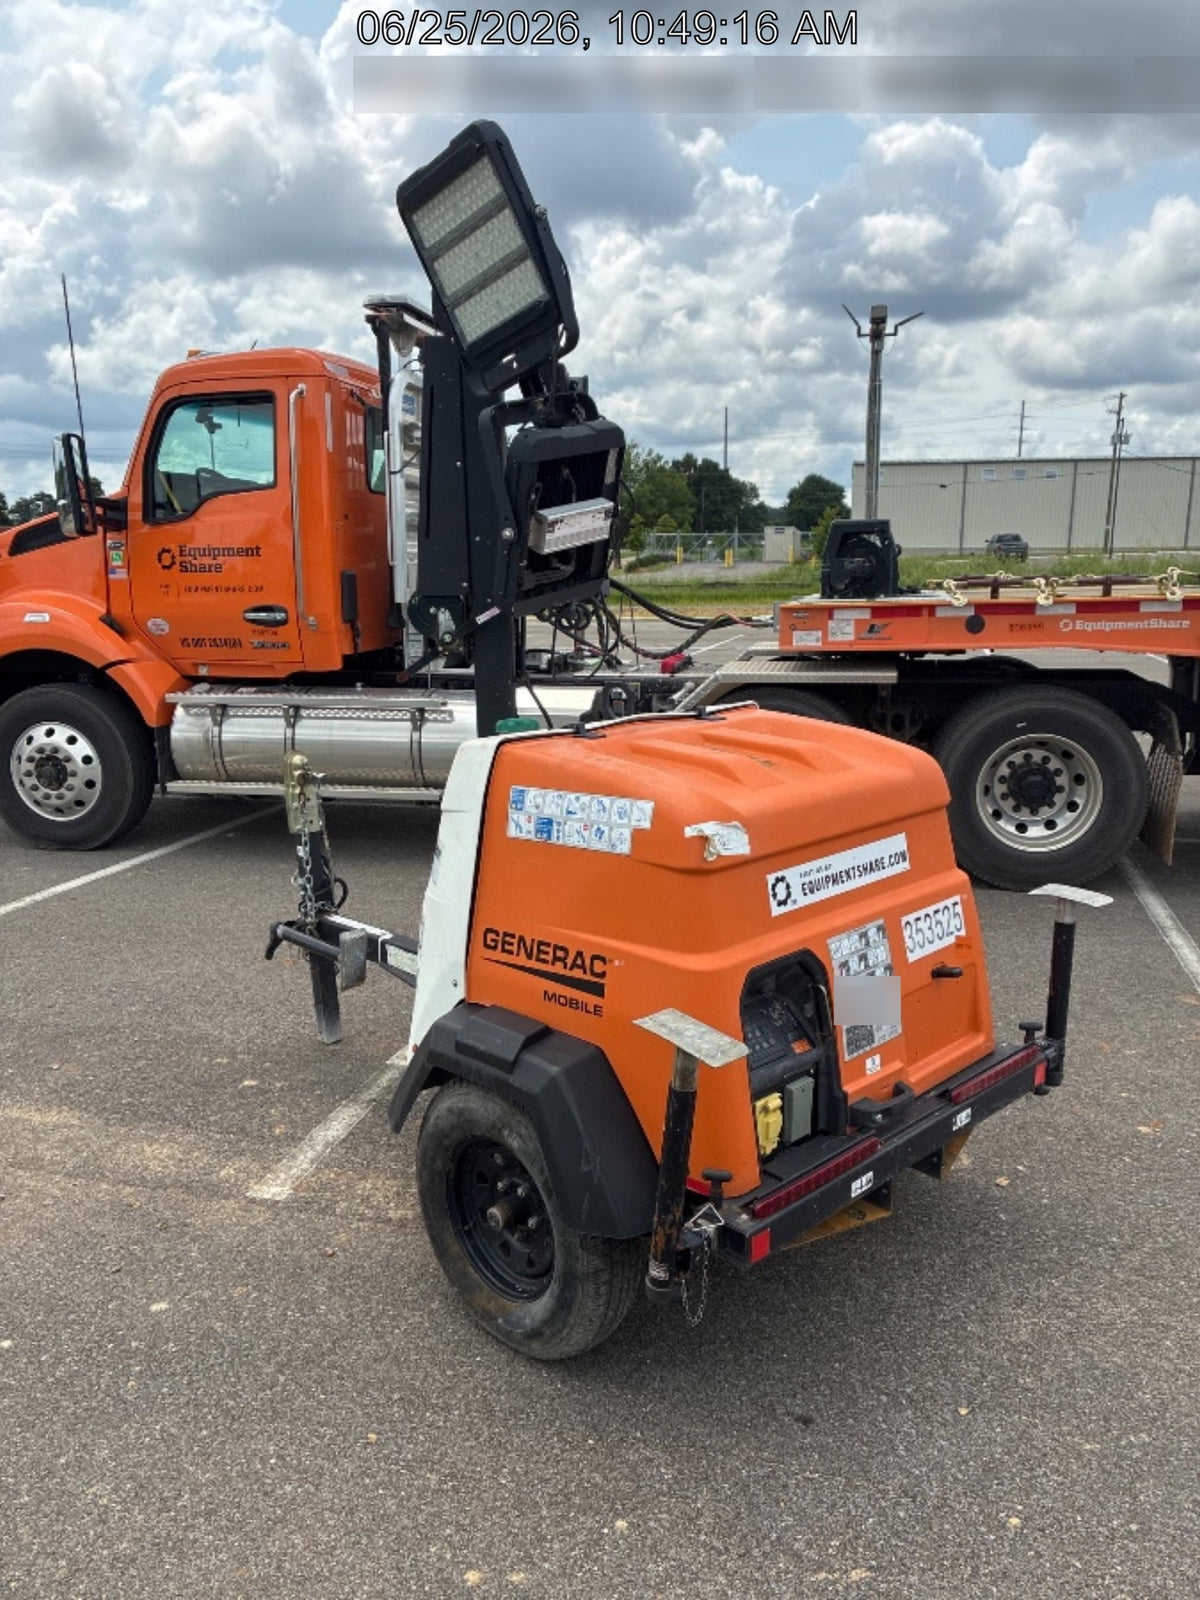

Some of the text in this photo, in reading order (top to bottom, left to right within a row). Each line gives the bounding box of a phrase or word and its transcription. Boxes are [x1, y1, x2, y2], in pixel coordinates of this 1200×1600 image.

[178, 545, 262, 560] Equipment
[179, 562, 223, 574] Share
[1075, 619, 1190, 632] EquipmentShare
[801, 849, 908, 897] EQUIPMENTSHARE.COM
[904, 901, 963, 953] 353525
[483, 927, 608, 979] GENERAC
[543, 990, 604, 1018] MOBILE
